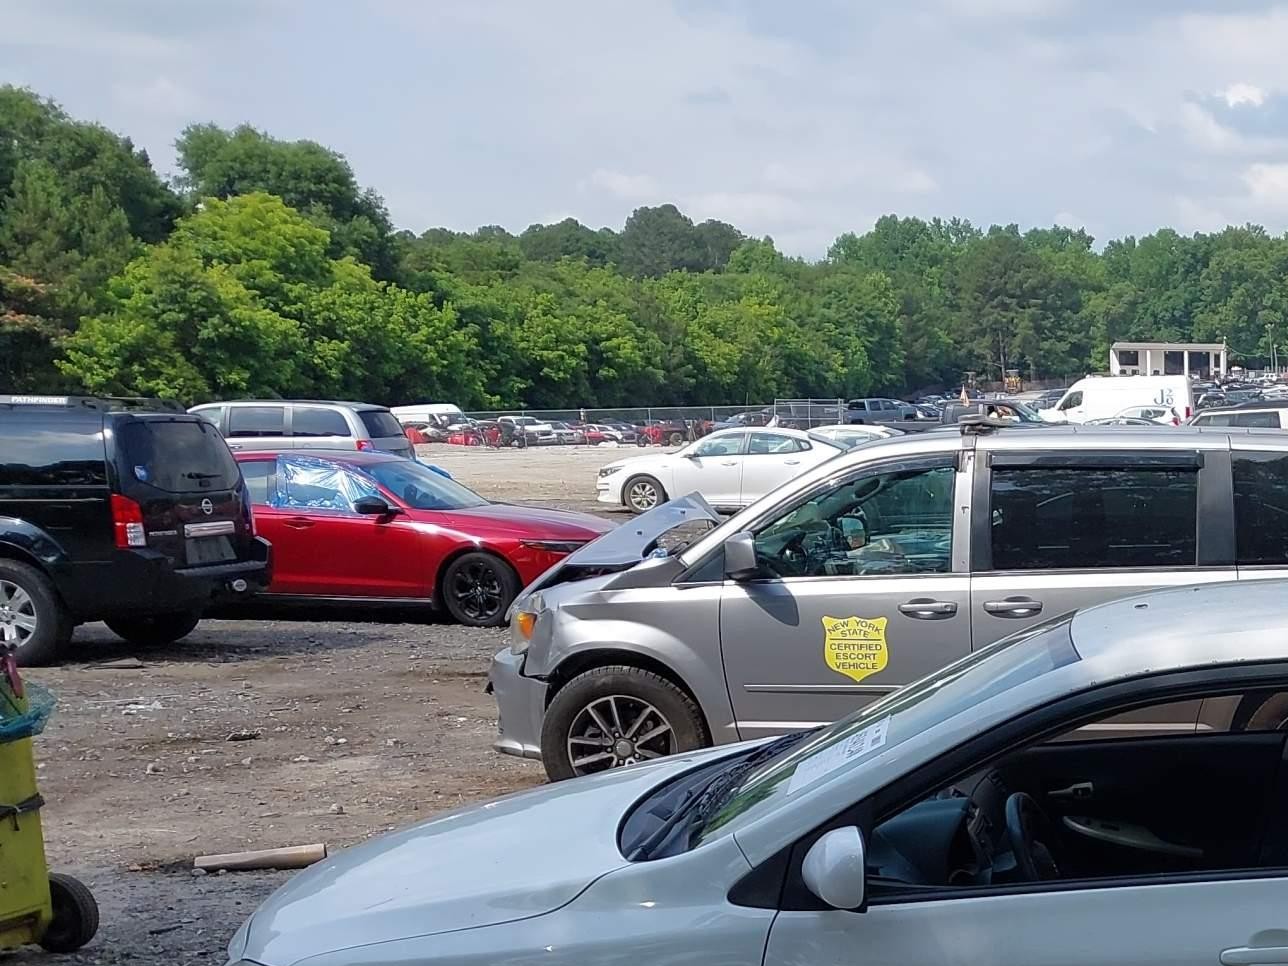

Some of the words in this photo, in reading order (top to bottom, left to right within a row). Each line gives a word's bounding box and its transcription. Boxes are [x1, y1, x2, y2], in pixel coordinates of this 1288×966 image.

[827, 620, 849, 635] NEW
[855, 619, 883, 635] YORK
[840, 628, 869, 638] STATE
[829, 643, 882, 651] CERTIFIED
[835, 652, 877, 660] ESCORT
[835, 661, 879, 670] VEHICLE
